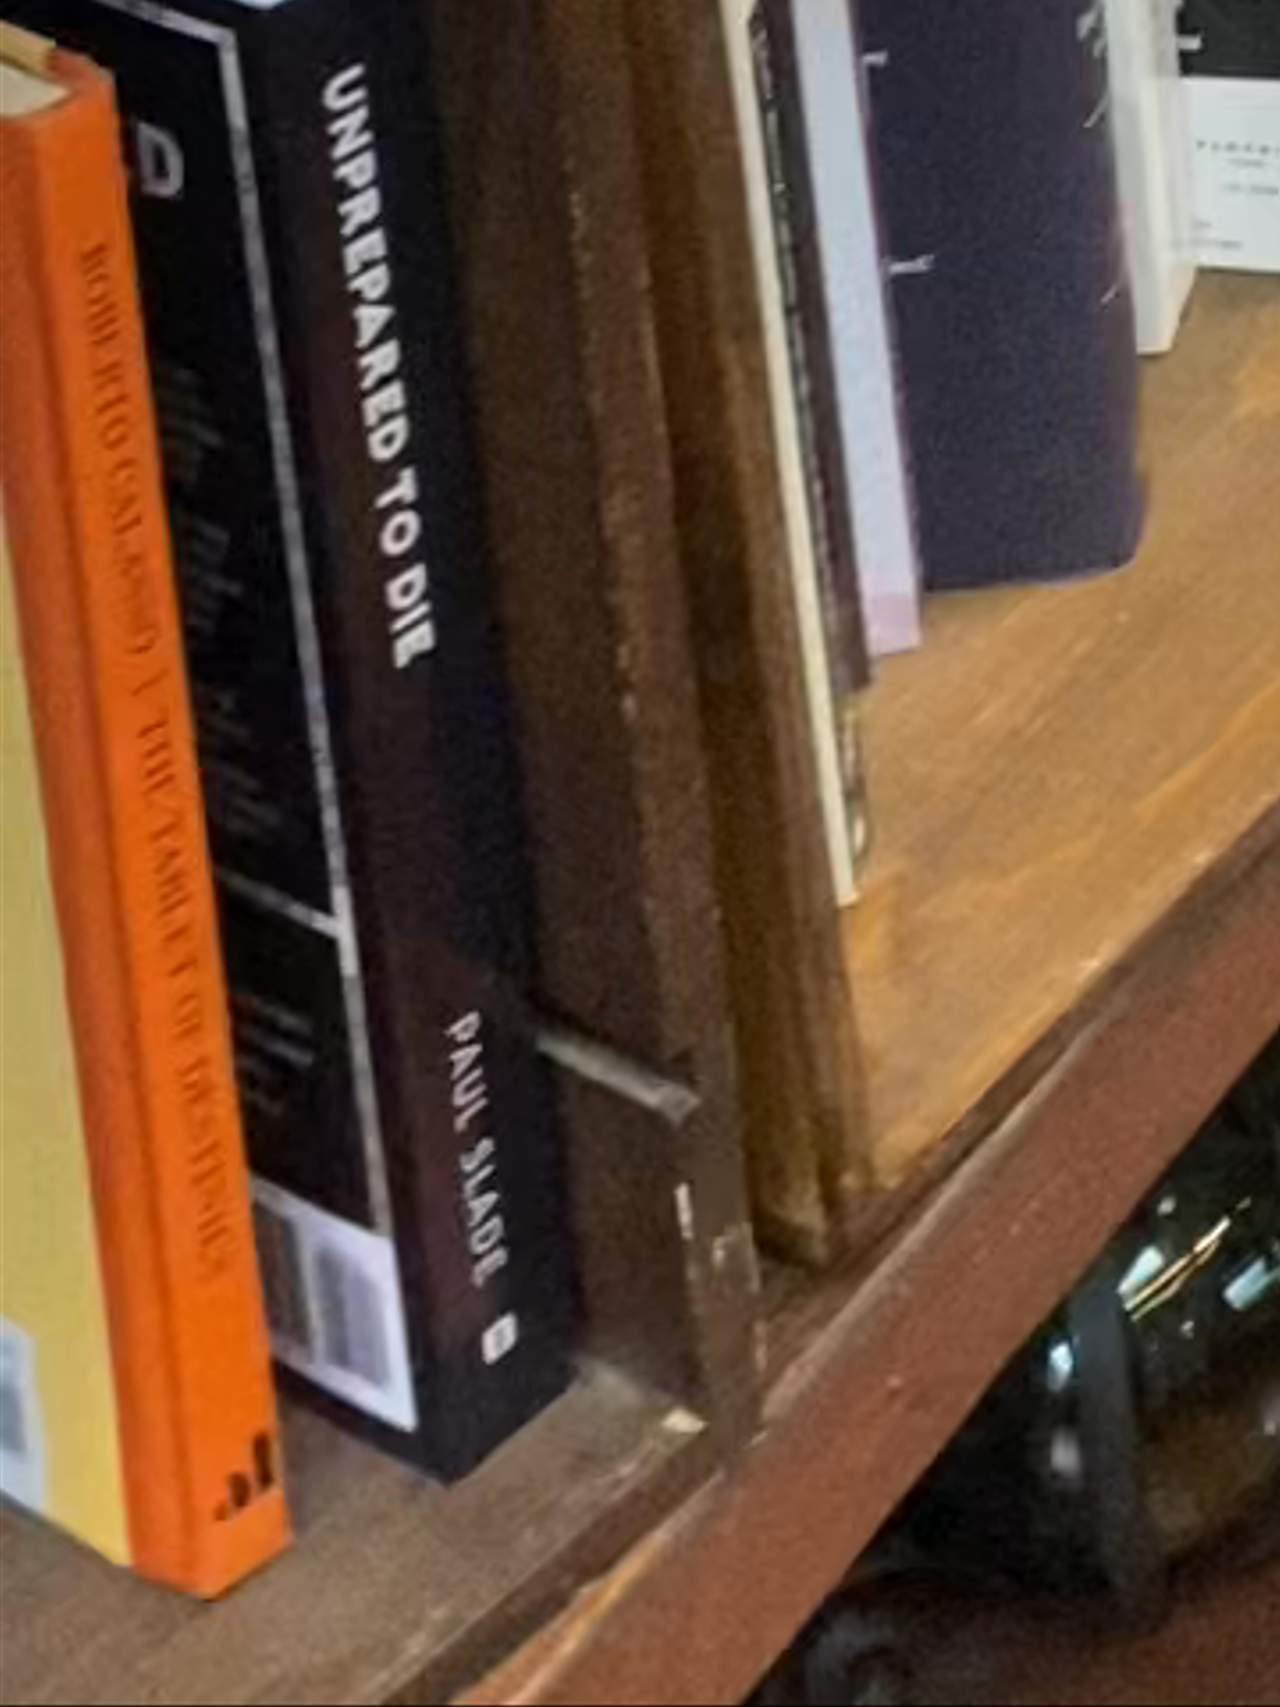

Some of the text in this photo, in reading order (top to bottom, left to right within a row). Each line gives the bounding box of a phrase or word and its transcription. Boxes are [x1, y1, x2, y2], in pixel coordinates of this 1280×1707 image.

[136, 120, 186, 202] D
[78, 241, 138, 452] ROBERTO
[321, 63, 437, 670] UNPREPARED TO DIE
[135, 718, 180, 802] THE
[142, 797, 202, 976] TABLET
[169, 989, 205, 1046] OF
[169, 1058, 235, 1278] DESTINIES
[445, 1009, 509, 1287] PAUL SLADE
